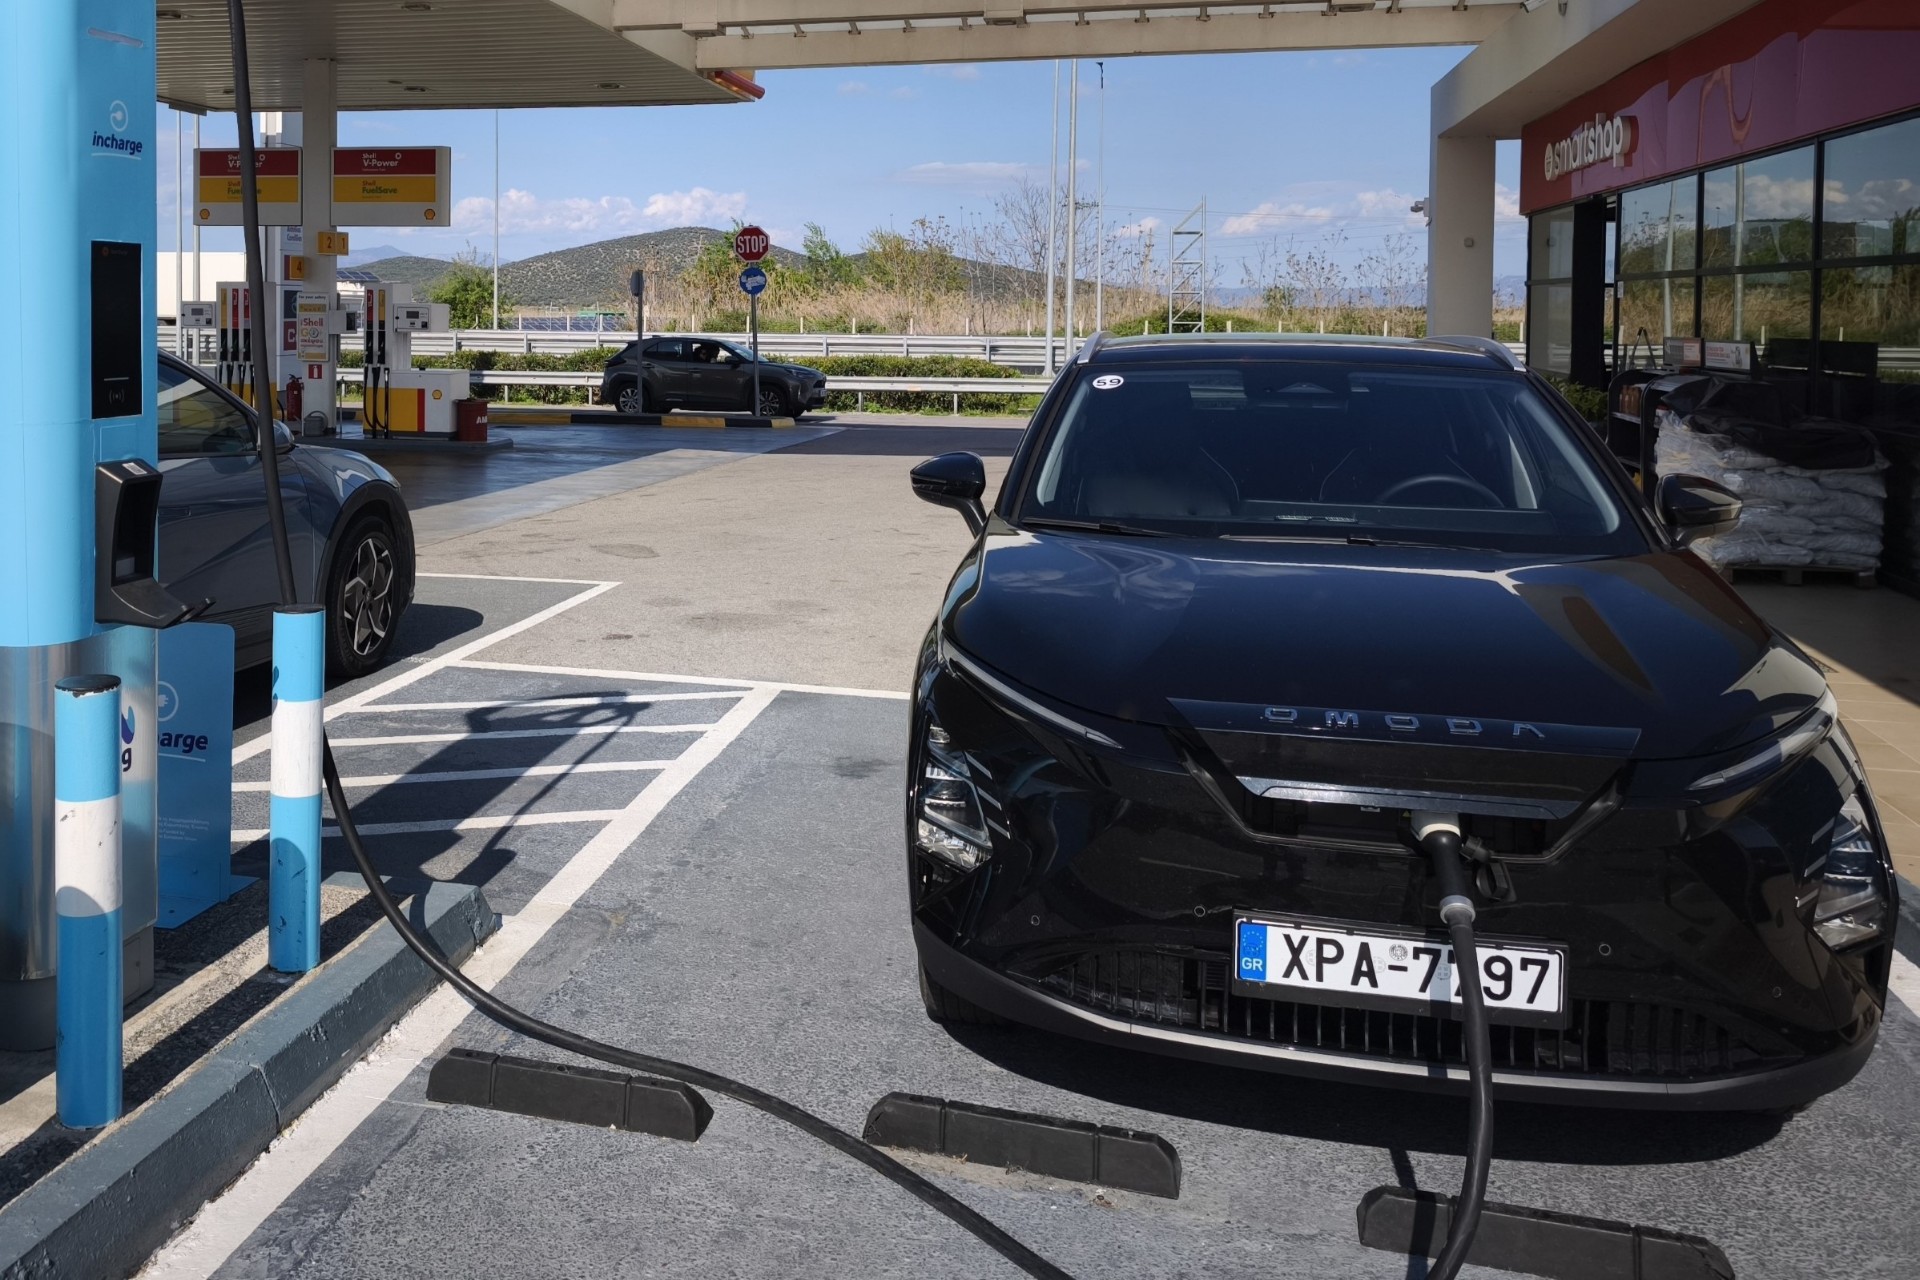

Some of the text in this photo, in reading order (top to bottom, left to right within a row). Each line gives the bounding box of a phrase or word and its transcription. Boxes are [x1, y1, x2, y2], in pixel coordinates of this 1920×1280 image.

[92, 131, 143, 155] incharge
[1553, 113, 1627, 175] smartshop
[228, 160, 263, 168] V-Per
[363, 159, 399, 167] V-Power
[362, 186, 398, 194] FuelSave
[327, 236, 332, 249] 2
[737, 235, 767, 254] STOP
[296, 260, 302, 273] 4
[303, 317, 324, 327] Shell
[1264, 706, 1546, 739] OMODA
[1241, 956, 1263, 973] GR
